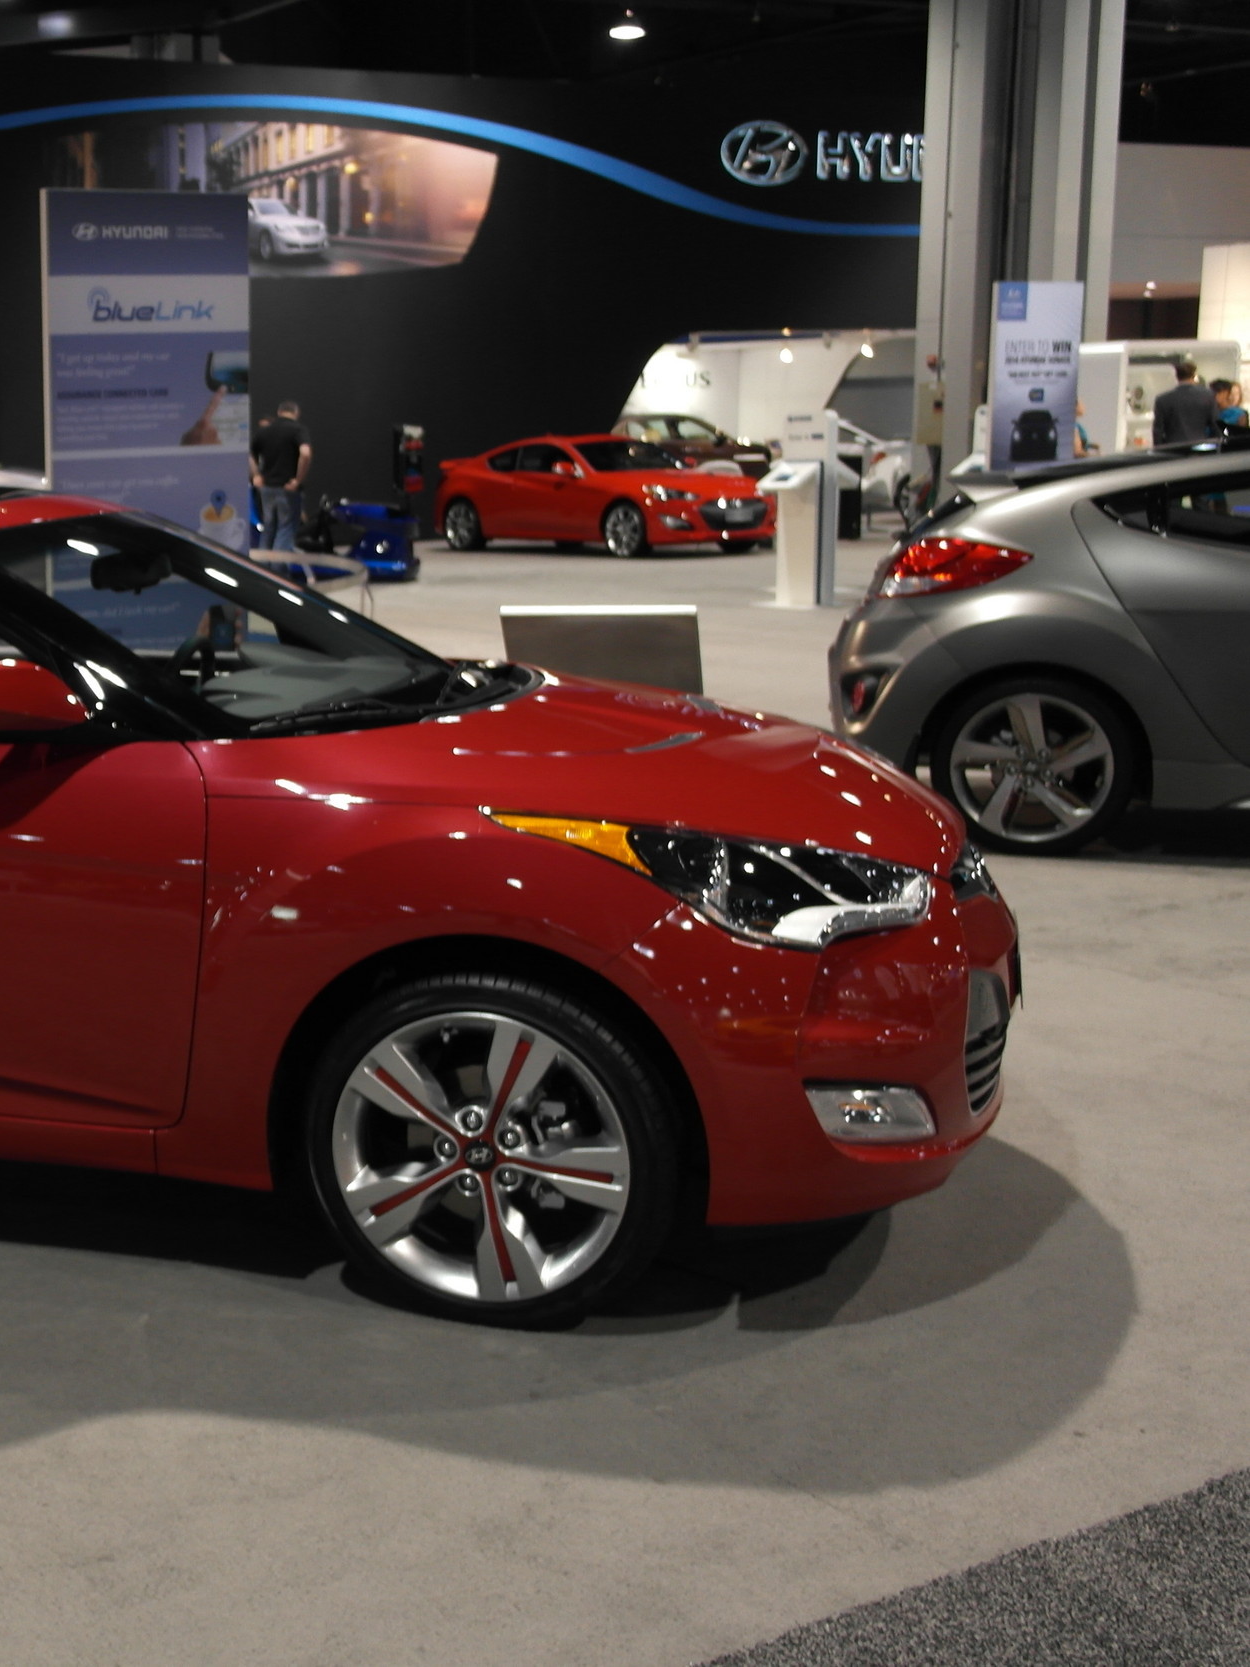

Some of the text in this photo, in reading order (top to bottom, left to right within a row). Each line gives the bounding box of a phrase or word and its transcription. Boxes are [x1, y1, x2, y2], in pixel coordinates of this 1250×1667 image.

[102, 225, 169, 240] HYUNDAI
[1005, 340, 1073, 353] ENTER TO WIN
